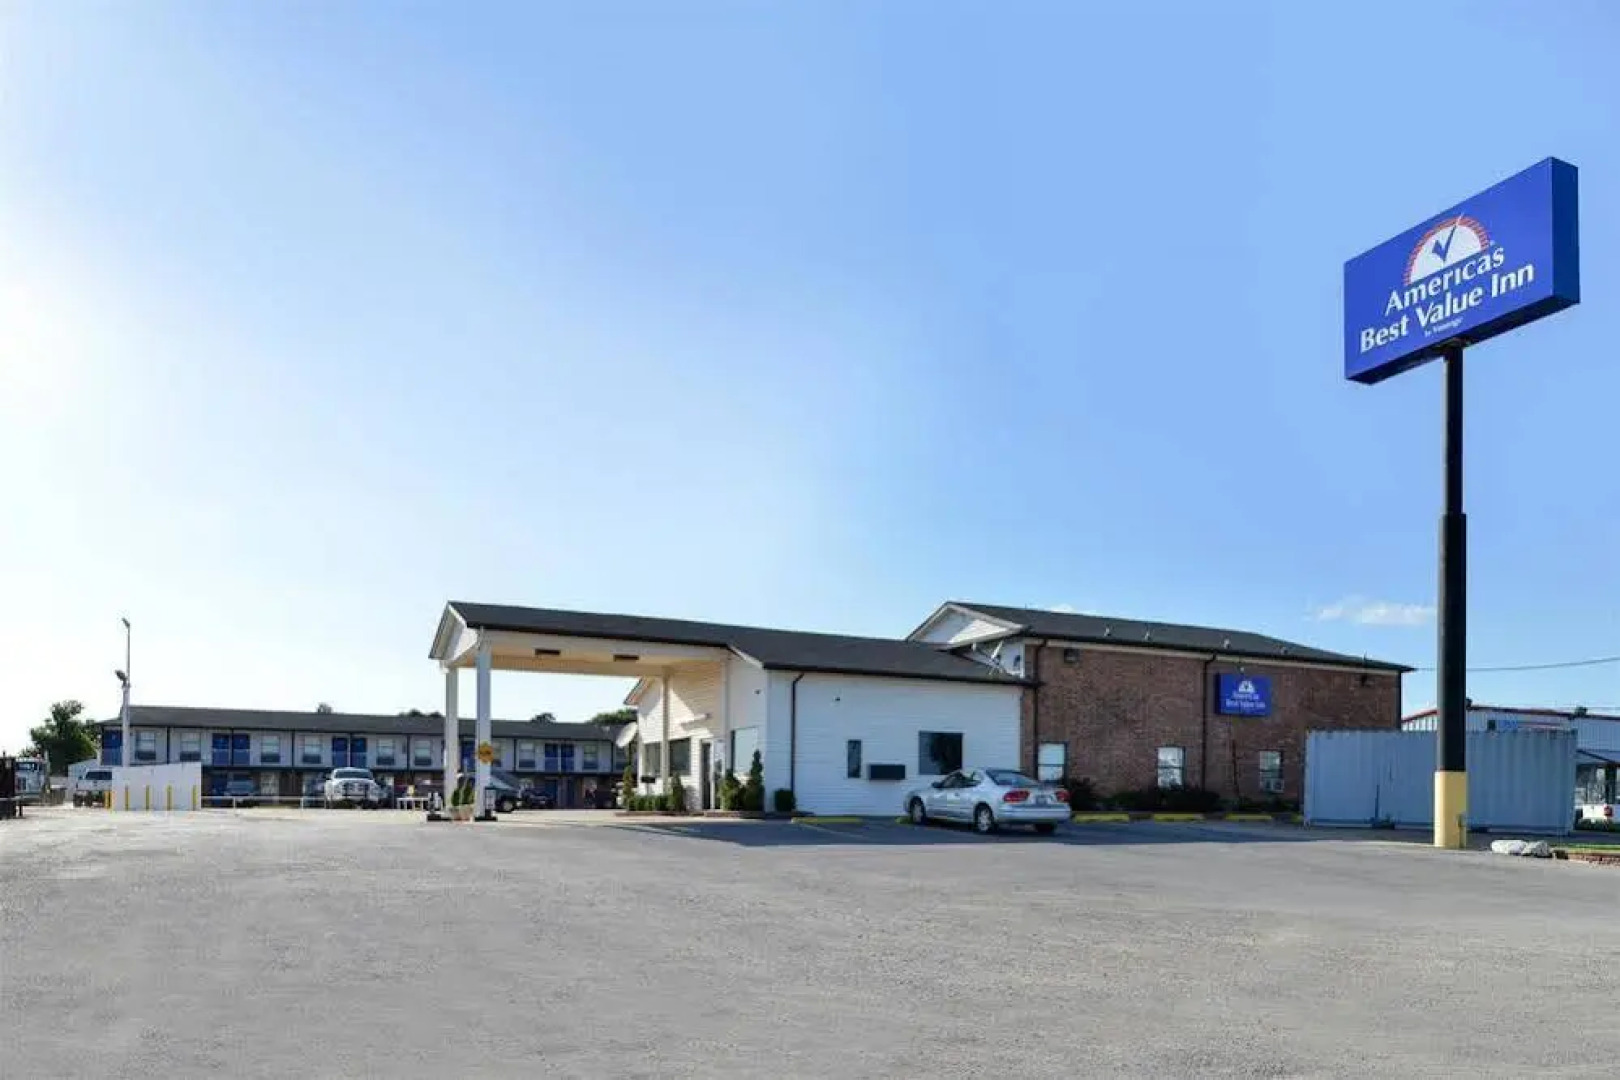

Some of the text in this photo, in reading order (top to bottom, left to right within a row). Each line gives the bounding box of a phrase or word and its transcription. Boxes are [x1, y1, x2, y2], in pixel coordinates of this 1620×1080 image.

[1360, 314, 1410, 354] Best
[1415, 286, 1483, 328] Value
[1491, 264, 1534, 298] Inn
[1385, 248, 1504, 315] Americas
